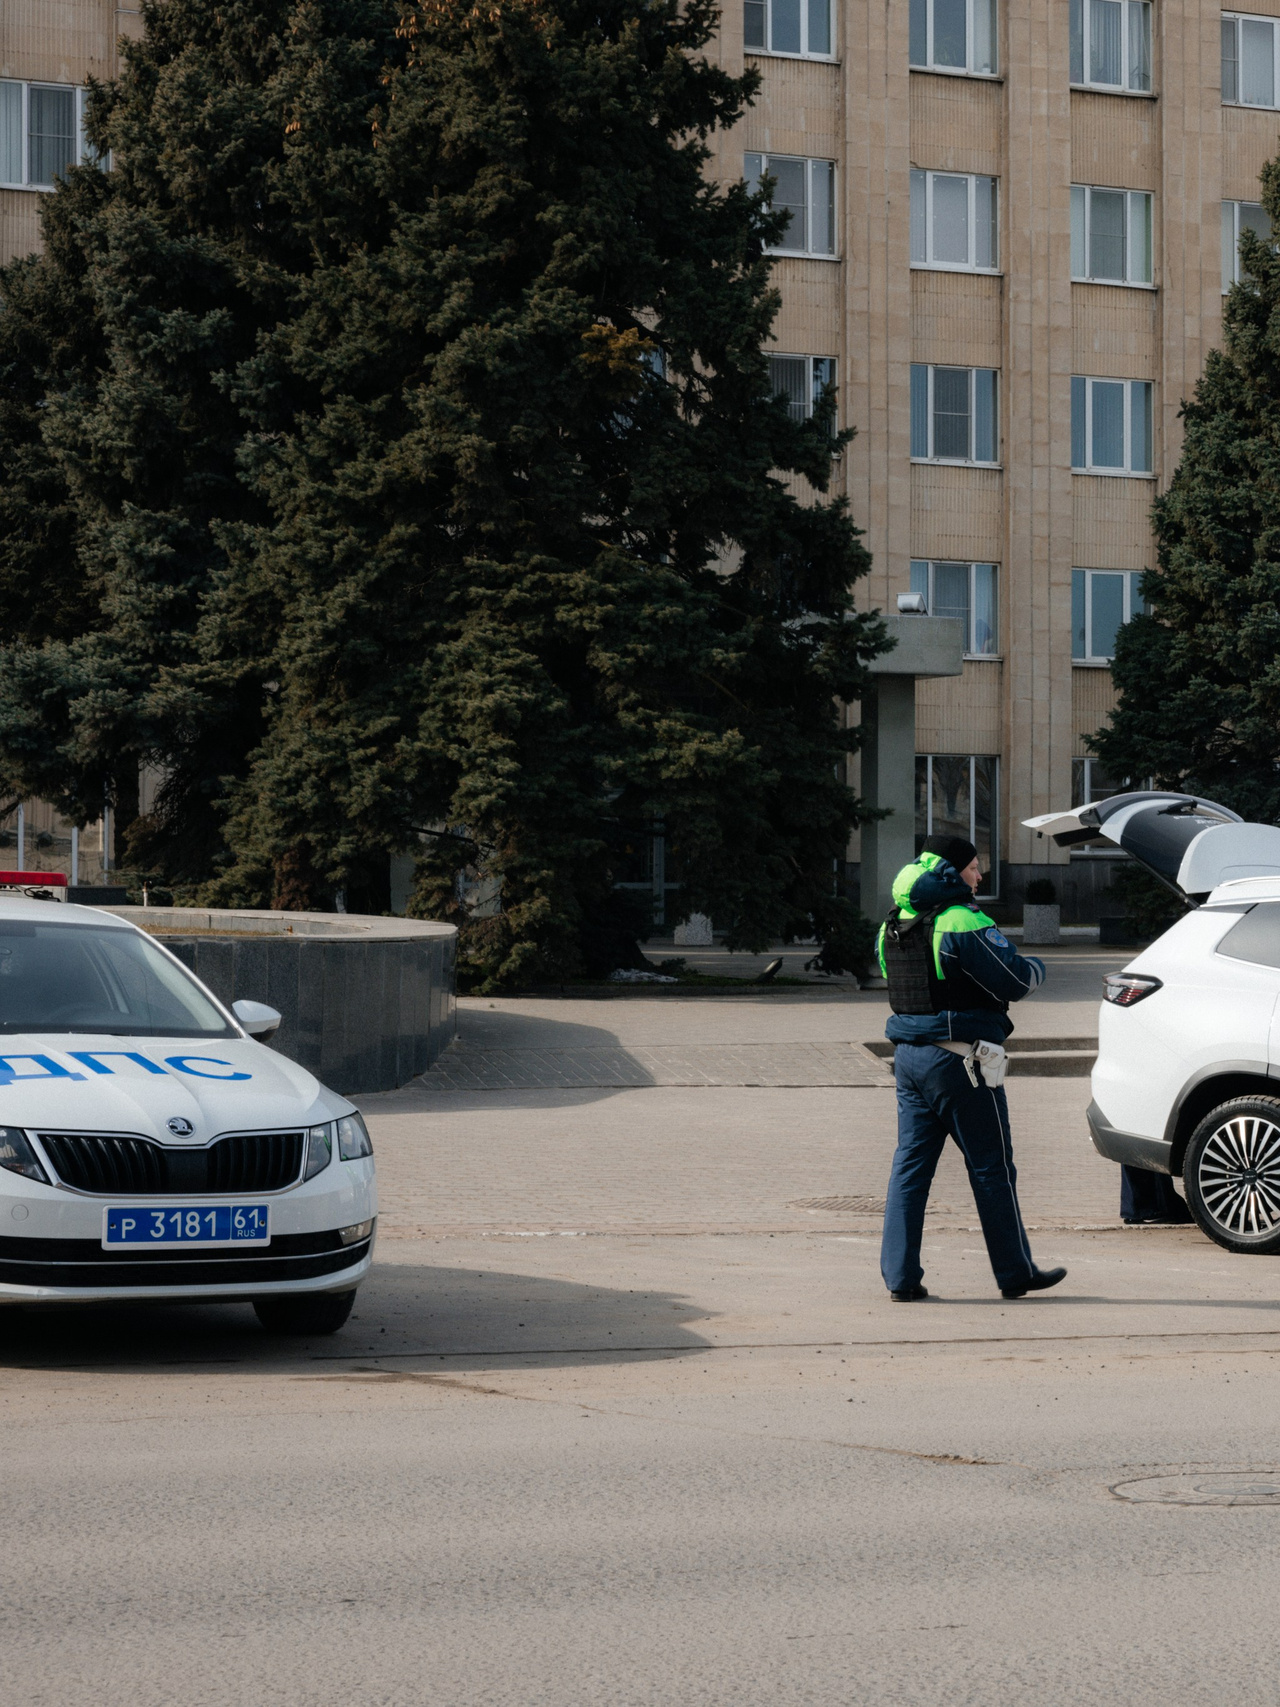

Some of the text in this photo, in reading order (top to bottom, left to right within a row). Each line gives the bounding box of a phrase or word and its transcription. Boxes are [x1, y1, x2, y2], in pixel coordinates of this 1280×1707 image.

[0, 1051, 253, 1085] ДПС
[150, 1211, 217, 1238] 3181
[234, 1208, 259, 1229] 61
[237, 1229, 256, 1237] RUS
